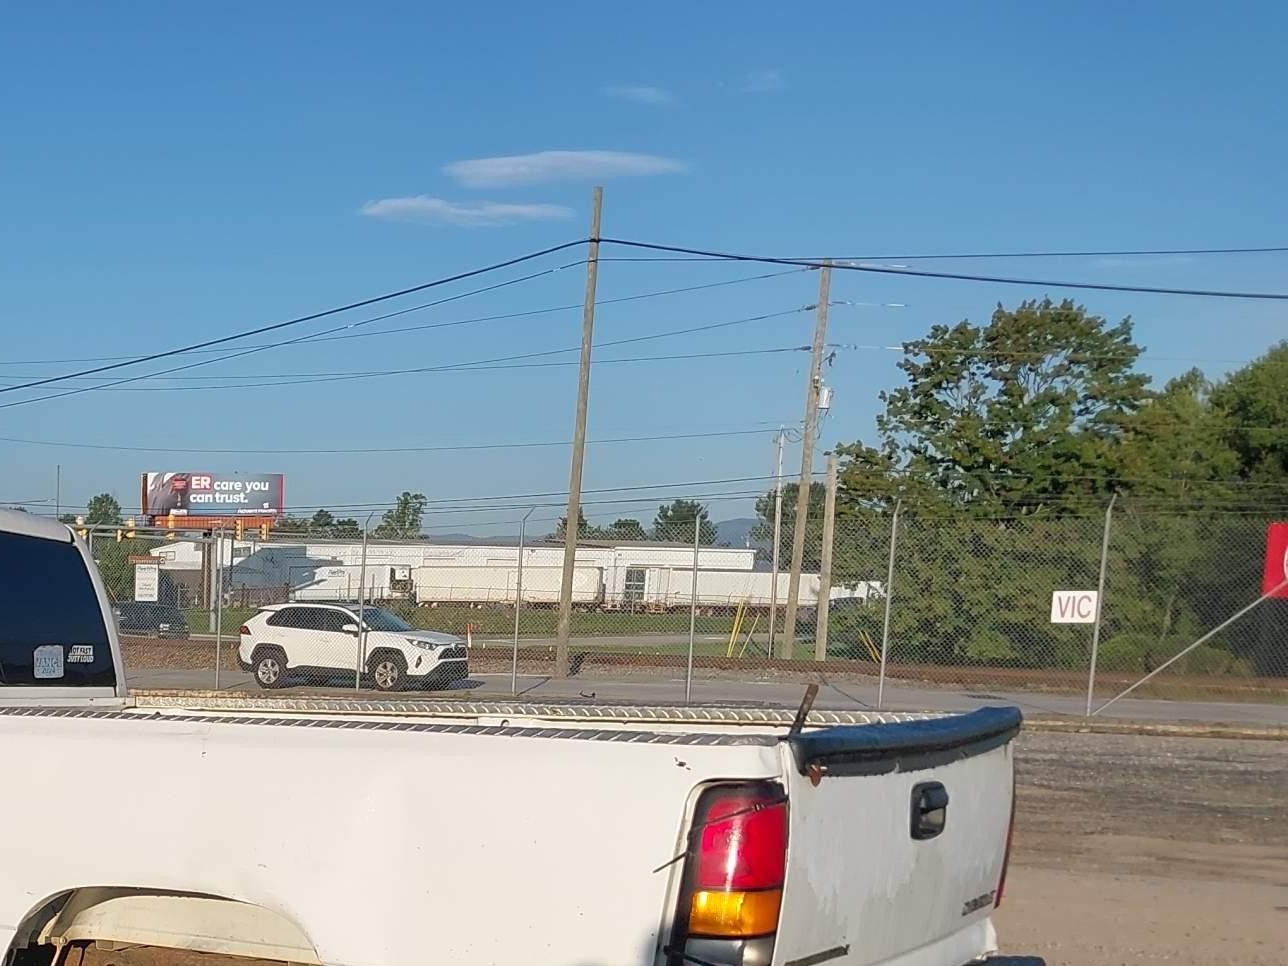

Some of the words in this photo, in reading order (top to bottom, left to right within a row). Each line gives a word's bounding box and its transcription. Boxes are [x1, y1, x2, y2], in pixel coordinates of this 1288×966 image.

[191, 476, 211, 489] ER
[213, 481, 242, 491] care
[245, 481, 269, 493] you
[189, 493, 213, 503] can
[215, 492, 249, 503] trust.
[1058, 595, 1092, 618] VIC
[67, 655, 80, 663] JUST
[80, 655, 94, 663] LOUD
